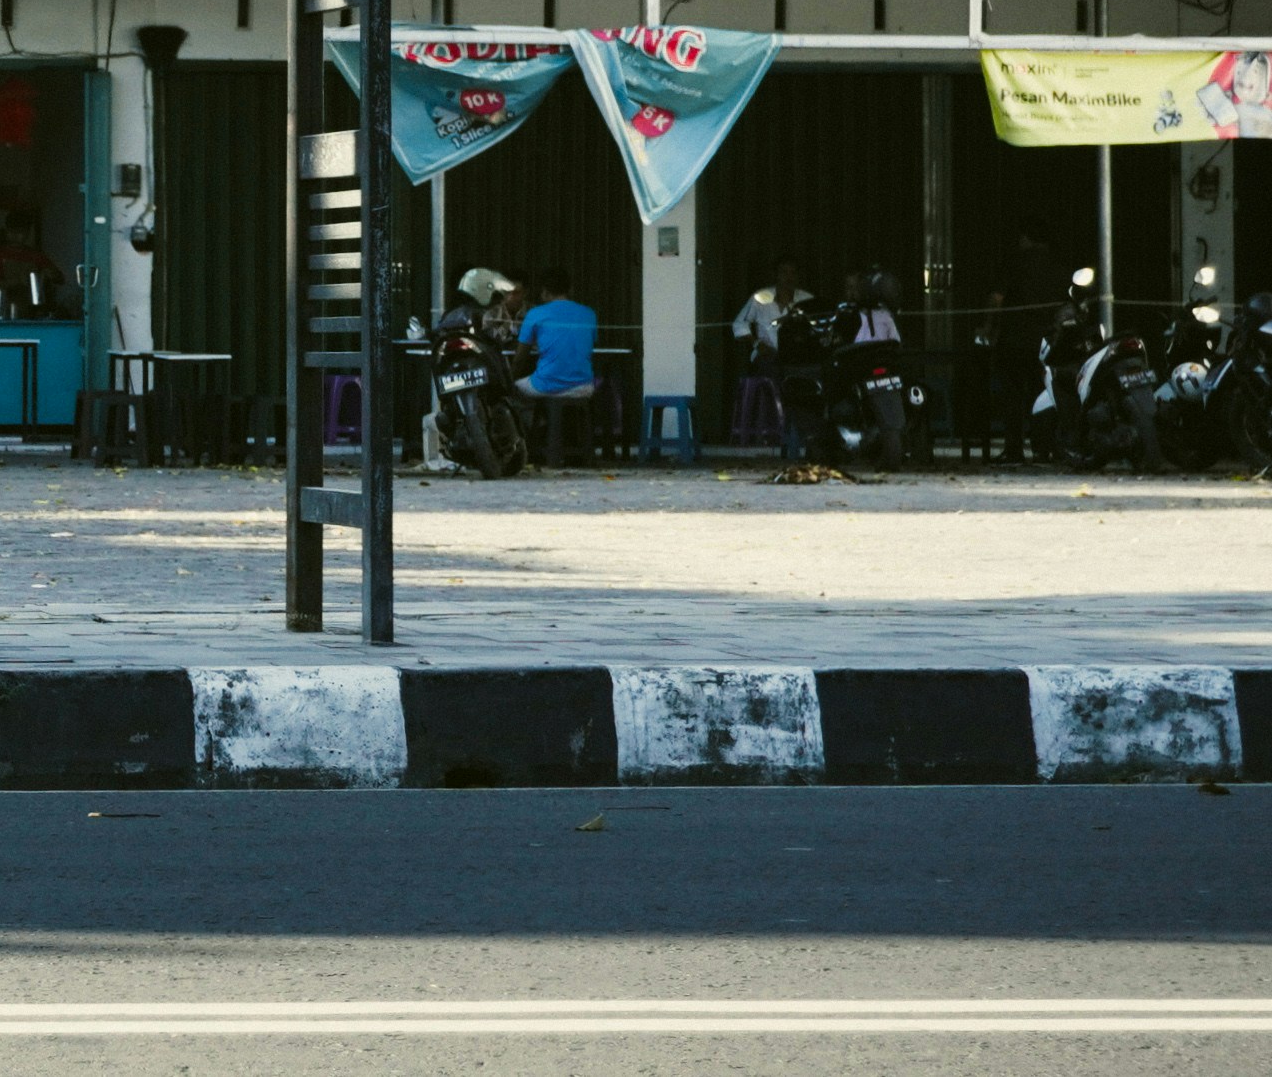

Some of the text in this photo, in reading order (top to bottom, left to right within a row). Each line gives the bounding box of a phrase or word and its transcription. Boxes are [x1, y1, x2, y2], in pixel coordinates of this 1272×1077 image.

[464, 93, 484, 109] 10
[1000, 88, 1142, 106] Pesan MaximBike
